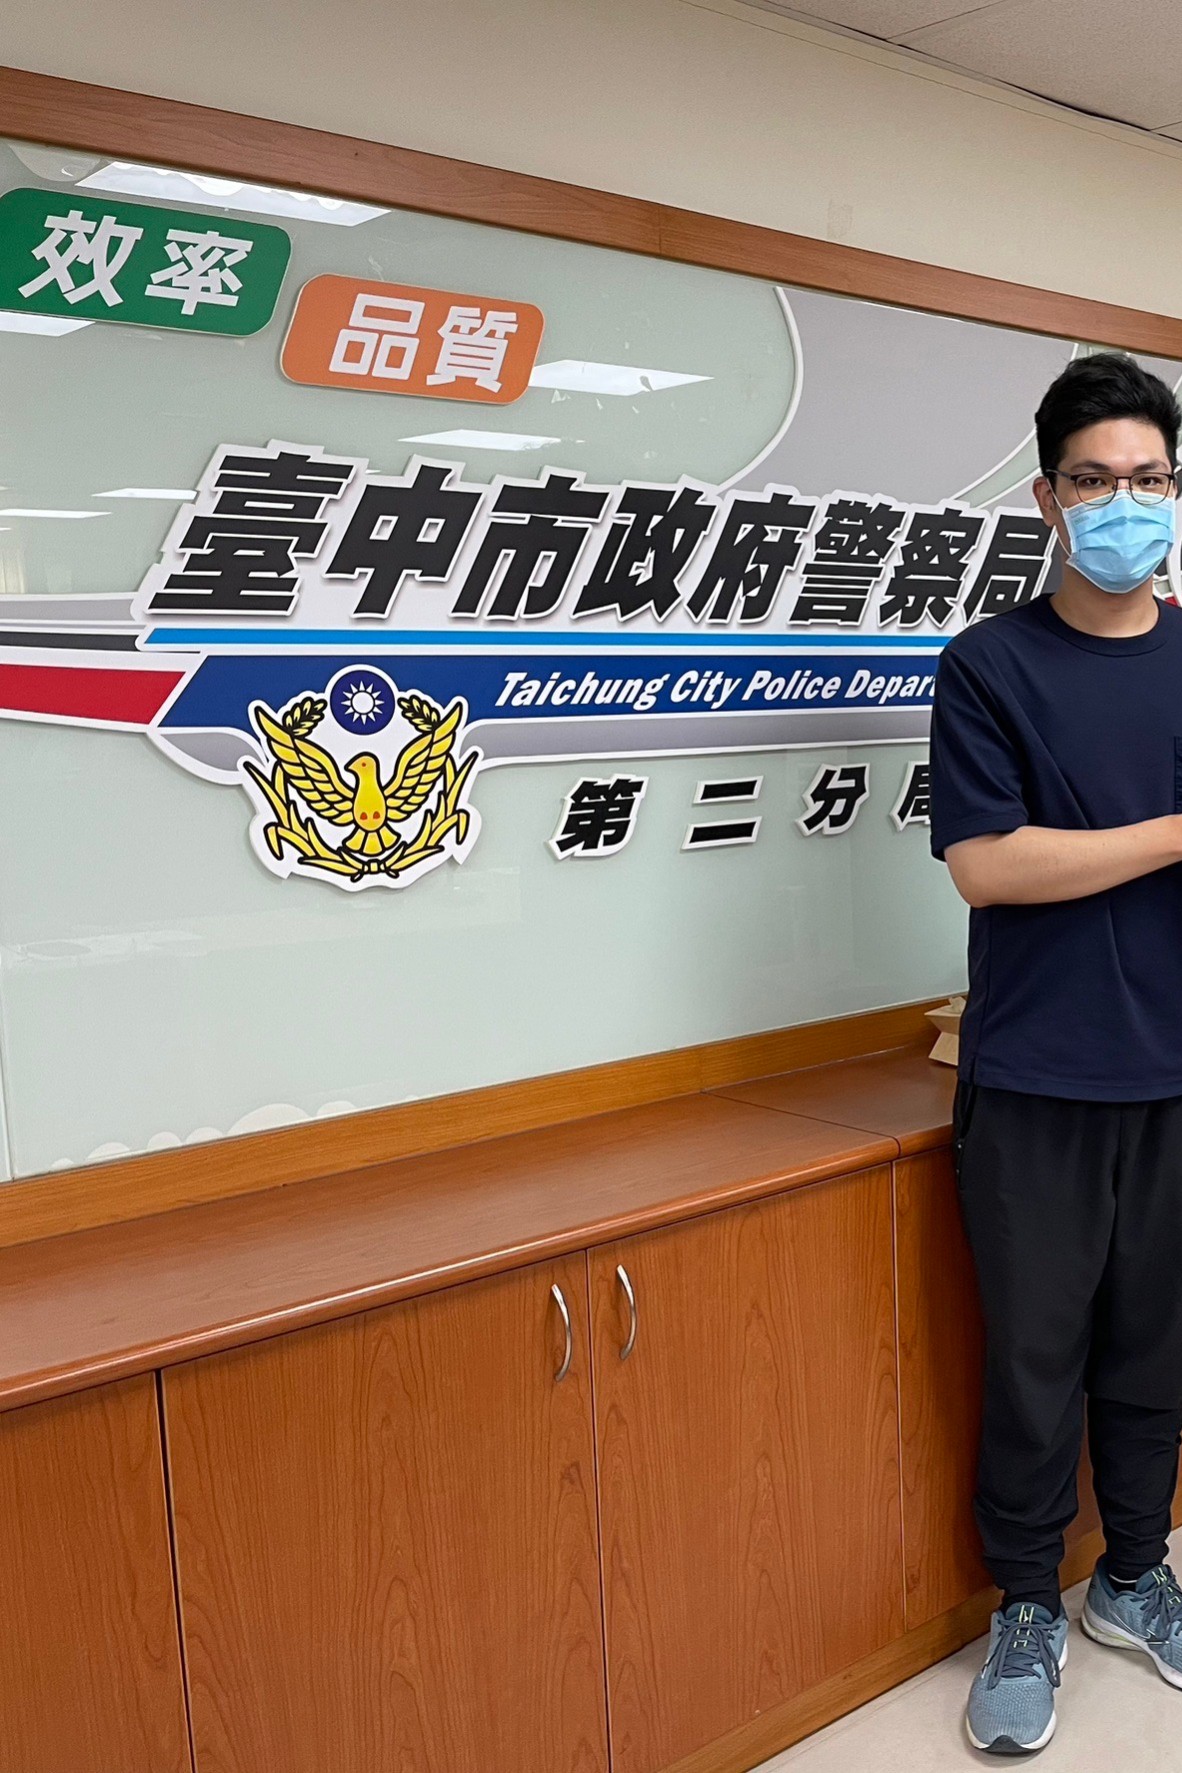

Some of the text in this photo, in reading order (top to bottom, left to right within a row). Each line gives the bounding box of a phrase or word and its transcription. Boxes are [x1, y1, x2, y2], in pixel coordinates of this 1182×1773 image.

[19, 210, 255, 316] 效率
[328, 291, 520, 393] 品質
[147, 452, 1056, 627] 臺中市政府警察局
[495, 671, 670, 712] Taichung
[670, 669, 743, 710] City
[741, 669, 842, 702] Police
